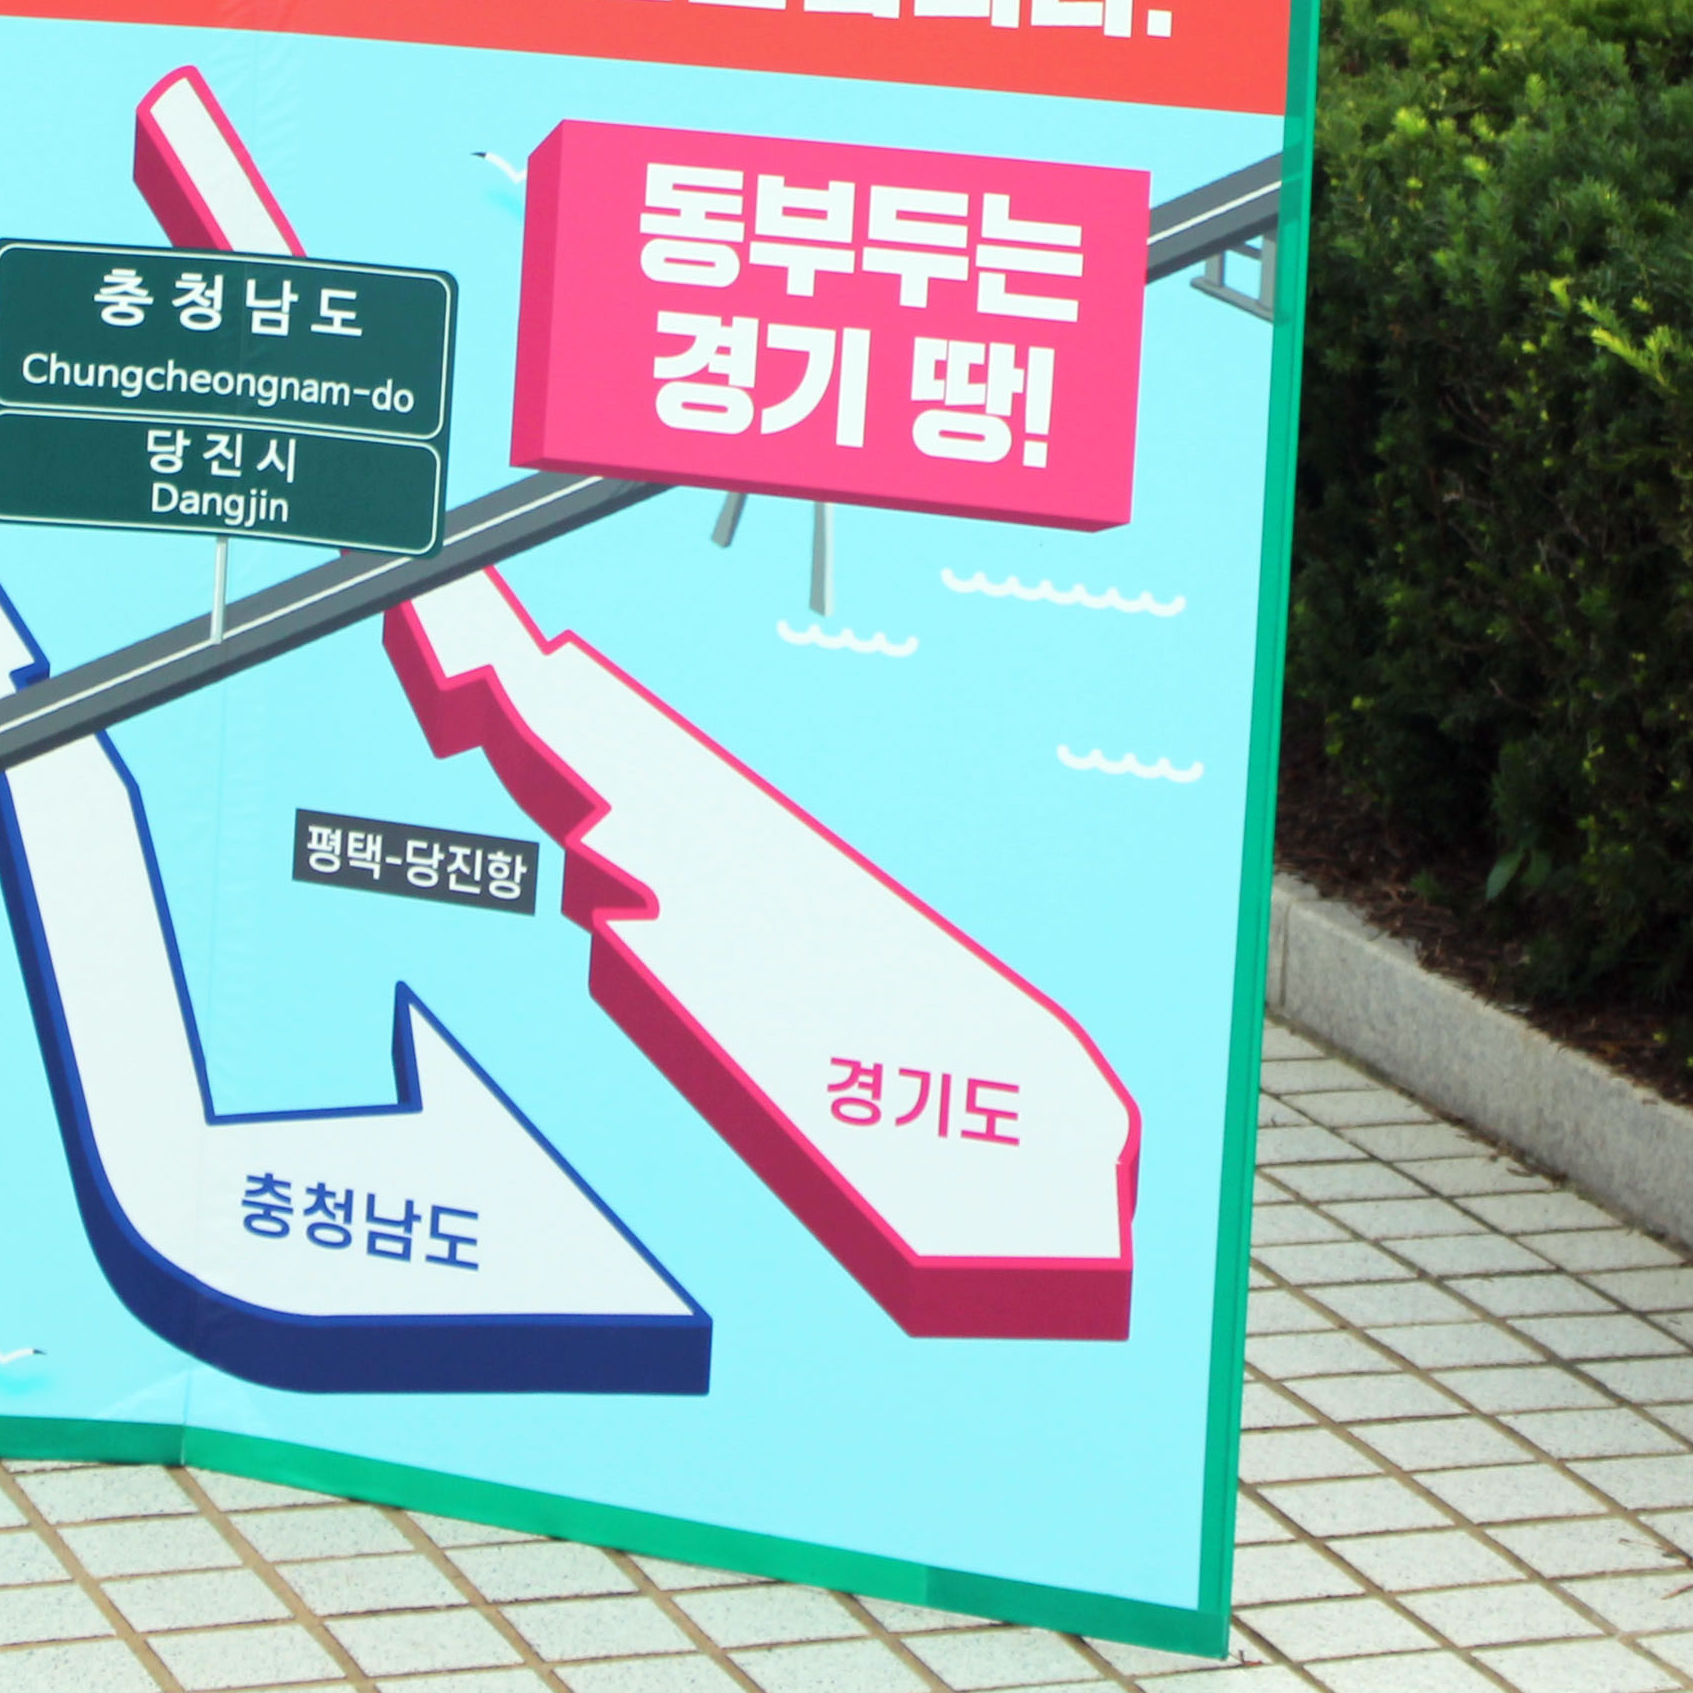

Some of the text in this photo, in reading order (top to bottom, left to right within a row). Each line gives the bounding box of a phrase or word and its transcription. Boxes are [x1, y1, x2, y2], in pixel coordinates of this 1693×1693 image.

[639, 162, 1083, 323] 동부두는
[94, 268, 364, 338] 충청남도
[21, 352, 414, 413] Chungcheongnam-do
[653, 311, 1055, 468] 경기 땅!
[146, 428, 297, 483] 당진시
[150, 482, 289, 527] Dangjin
[306, 824, 528, 900] 평택-당진항
[825, 1056, 1021, 1148] 경기도
[240, 1172, 481, 1272] 충청남도
